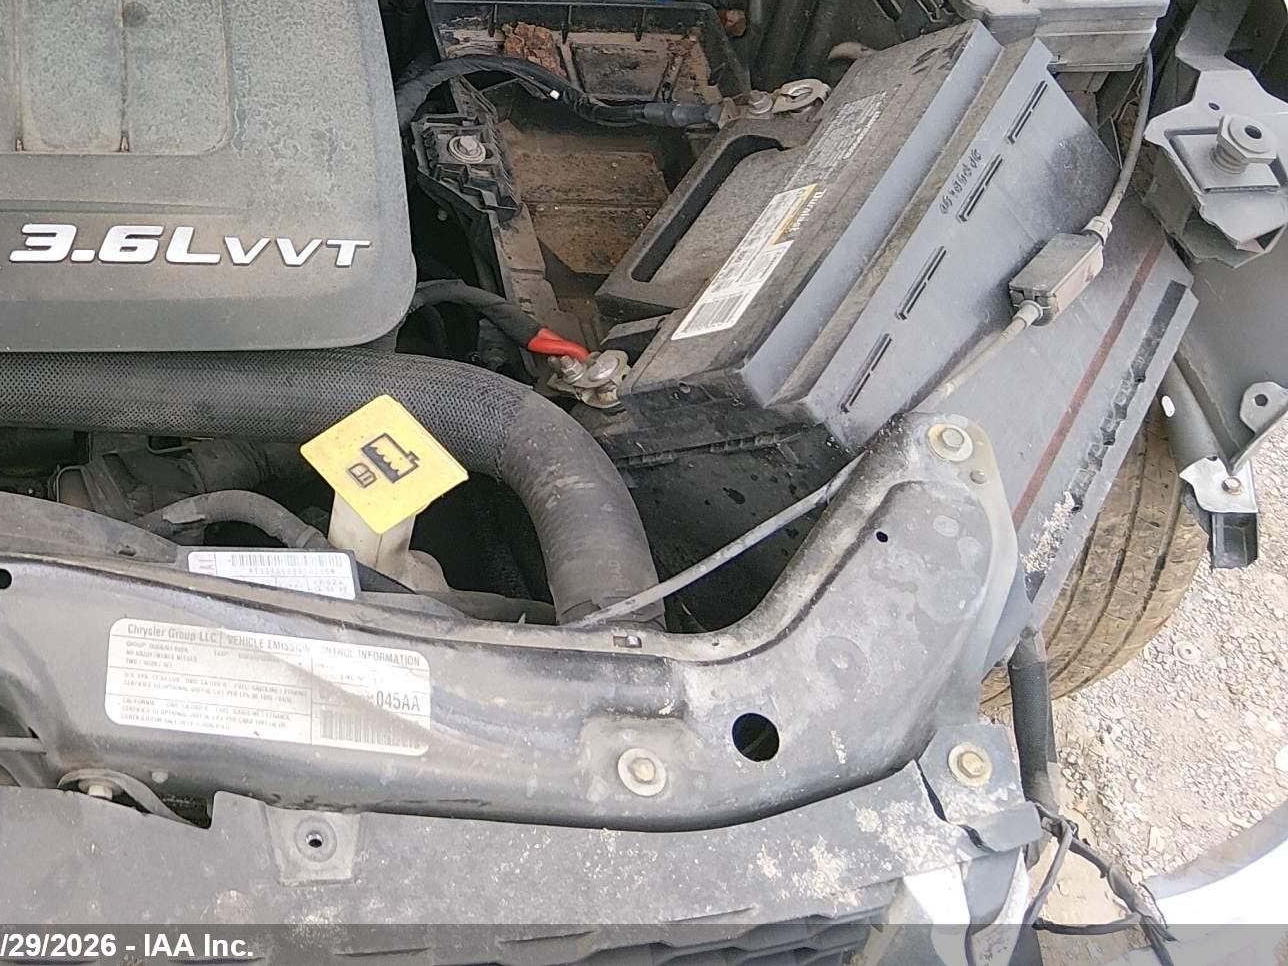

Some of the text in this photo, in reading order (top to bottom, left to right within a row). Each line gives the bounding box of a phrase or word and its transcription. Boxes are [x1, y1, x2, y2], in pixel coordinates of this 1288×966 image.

[127, 623, 165, 638] Chrysler
[168, 627, 196, 642] Group
[199, 631, 217, 643] LLC
[227, 634, 265, 650] VEHICLE
[357, 649, 421, 667] INFORMATION
